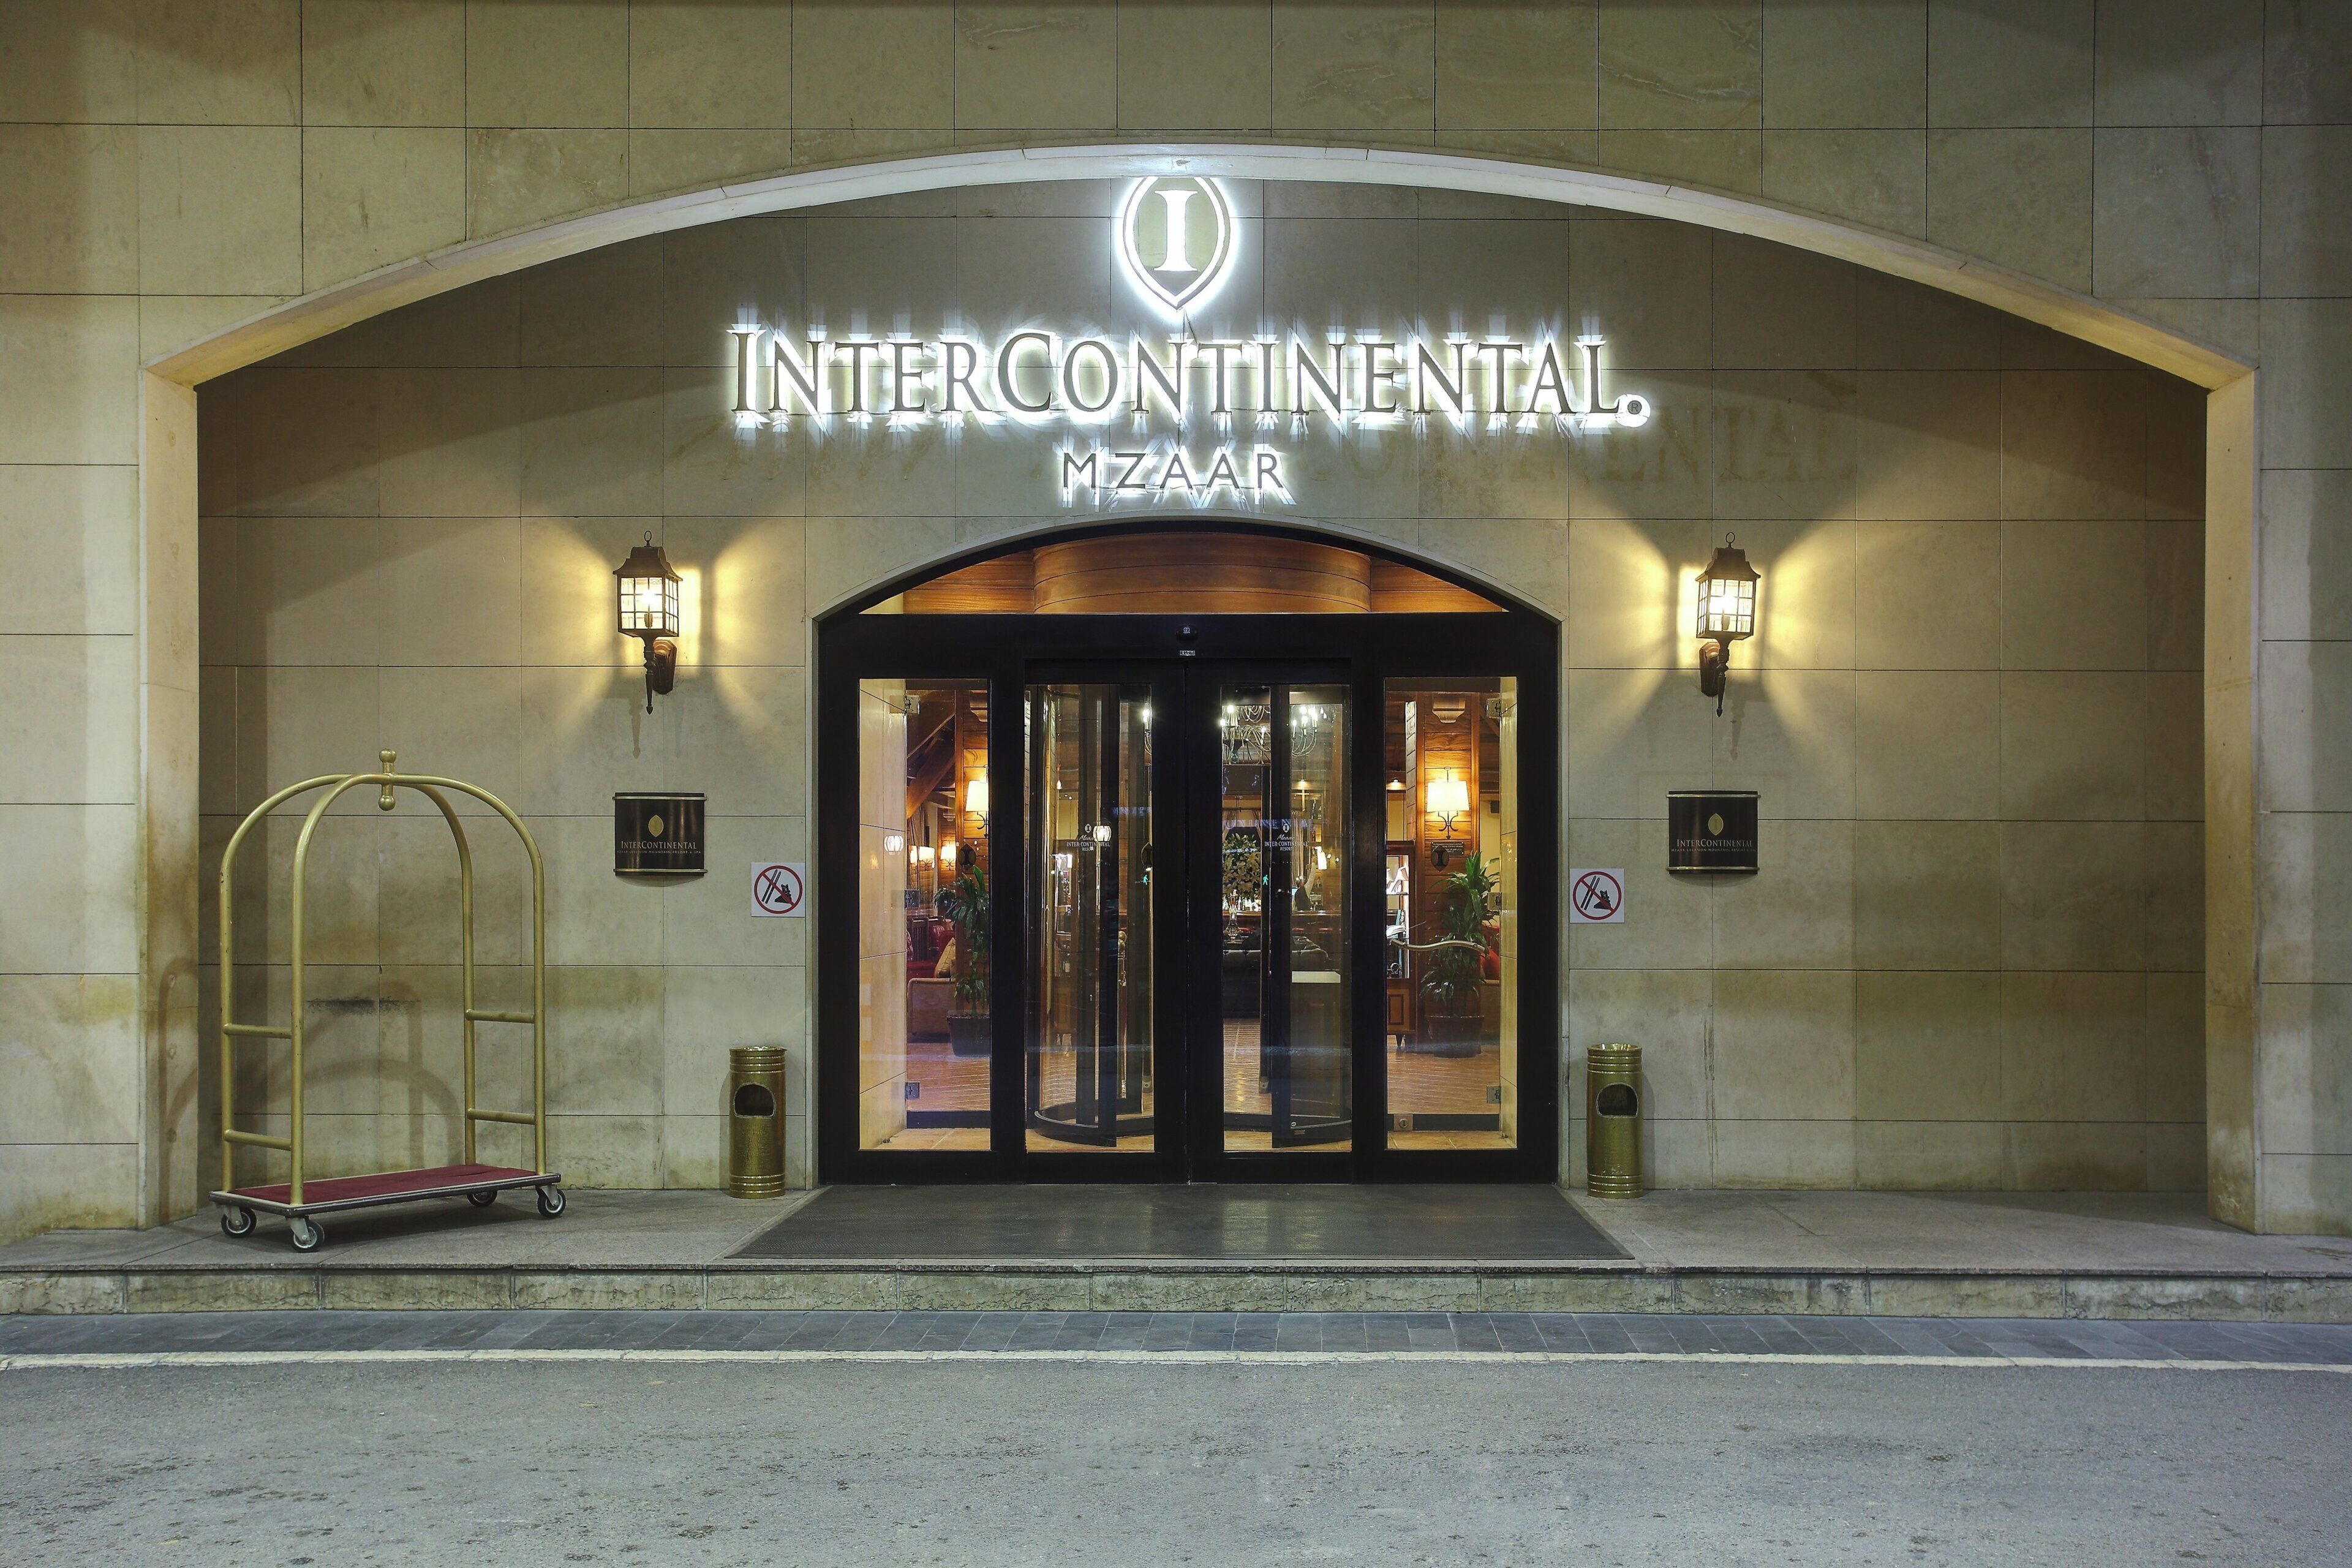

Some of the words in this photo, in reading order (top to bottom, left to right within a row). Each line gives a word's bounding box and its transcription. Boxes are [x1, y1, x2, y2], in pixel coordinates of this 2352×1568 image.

[731, 331, 1620, 415] INTERCONTINENTAL
[1063, 452, 1284, 489] MZAAR
[621, 840, 697, 850] INTERCONTINENTAL
[1676, 839, 1752, 847] INTERCONTINENTAL
